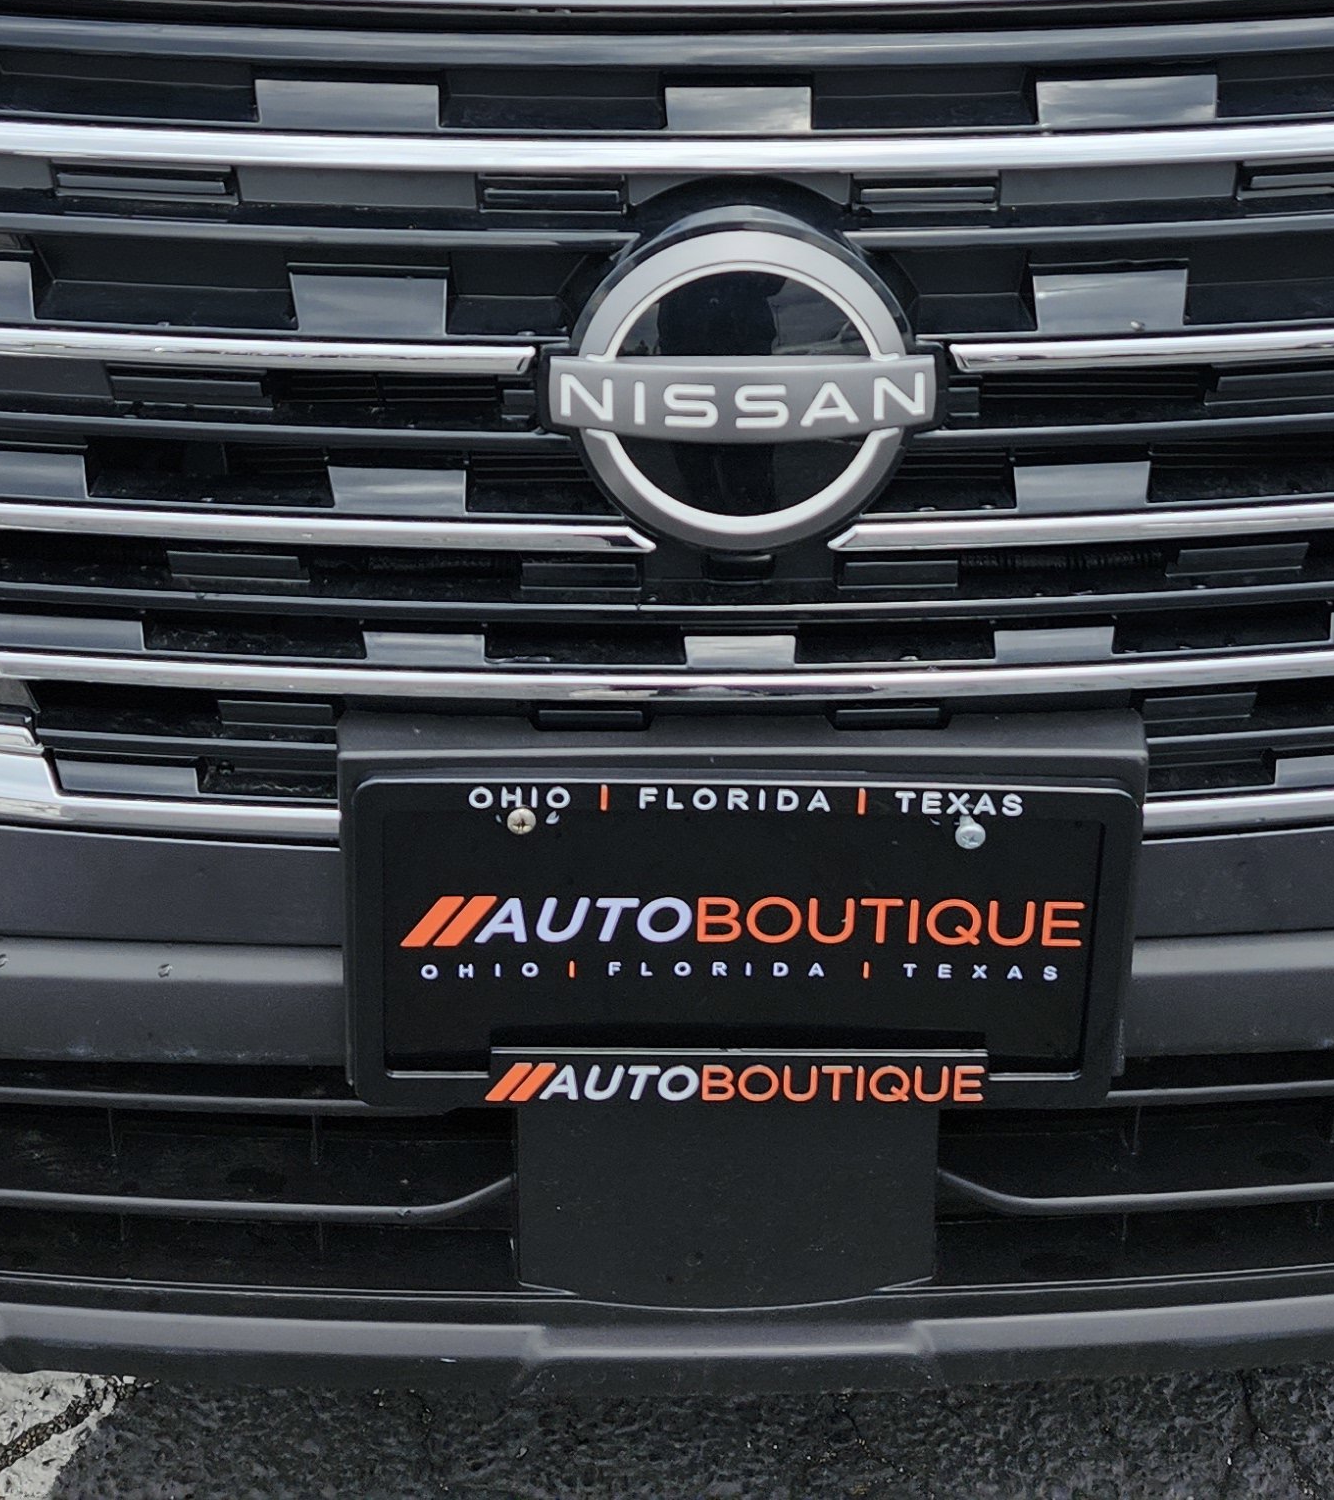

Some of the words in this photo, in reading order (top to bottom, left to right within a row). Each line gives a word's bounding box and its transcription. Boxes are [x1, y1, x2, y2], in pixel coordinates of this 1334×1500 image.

[560, 372, 926, 430] NISSAN
[468, 786, 571, 809] OHIO
[639, 787, 831, 812] FLORIDA
[895, 791, 1024, 817] TEXAS
[474, 896, 1085, 948] AUTOBOUTIQUE
[420, 962, 539, 980] OHIO
[608, 961, 825, 978] FLORIDA
[903, 964, 1058, 981] TEXAS
[539, 1064, 985, 1102] AUTOBOUTIQUE
